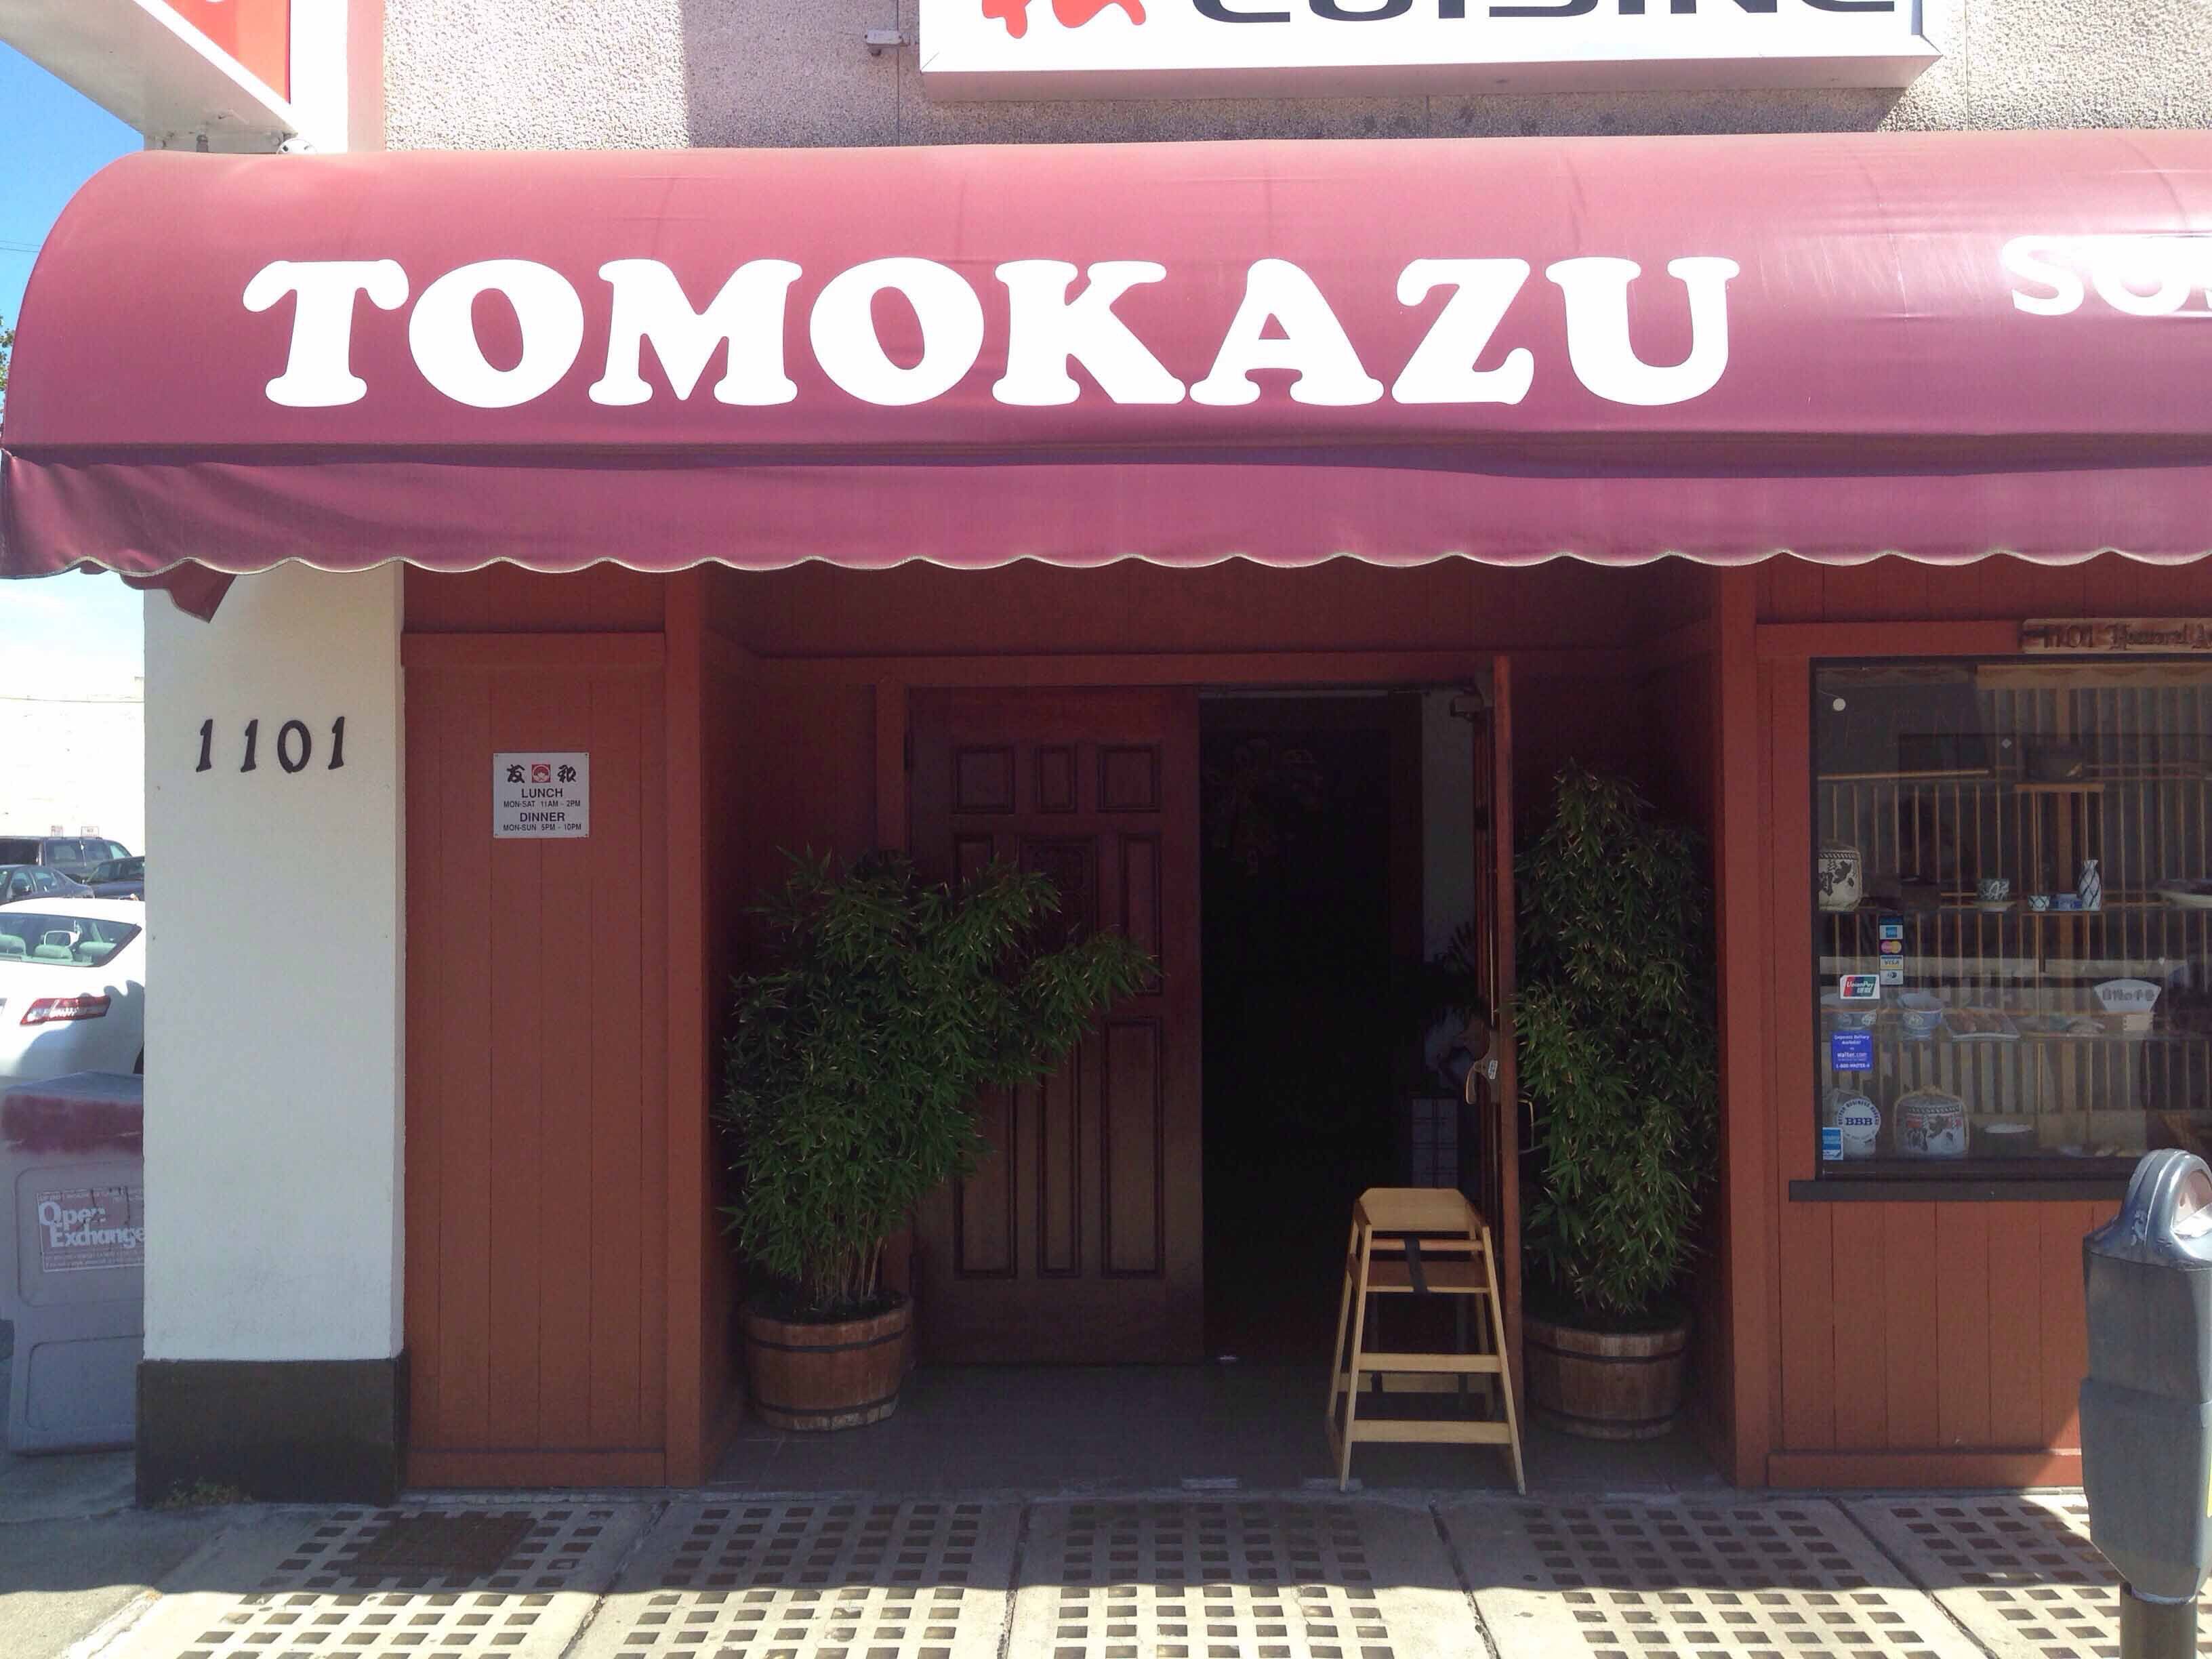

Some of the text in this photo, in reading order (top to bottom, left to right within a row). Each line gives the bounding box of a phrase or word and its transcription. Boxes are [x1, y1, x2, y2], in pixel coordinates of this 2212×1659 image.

[242, 257, 1740, 408] TOMOKAZU
[196, 716, 345, 773] 1101
[521, 788, 563, 798] LUNCH
[520, 813, 565, 822] DINNER
[503, 823, 537, 832] MON-SUN
[541, 823, 556, 831] 5PM
[564, 823, 581, 831] 10PM
[1845, 1118, 1872, 1126] BBB
